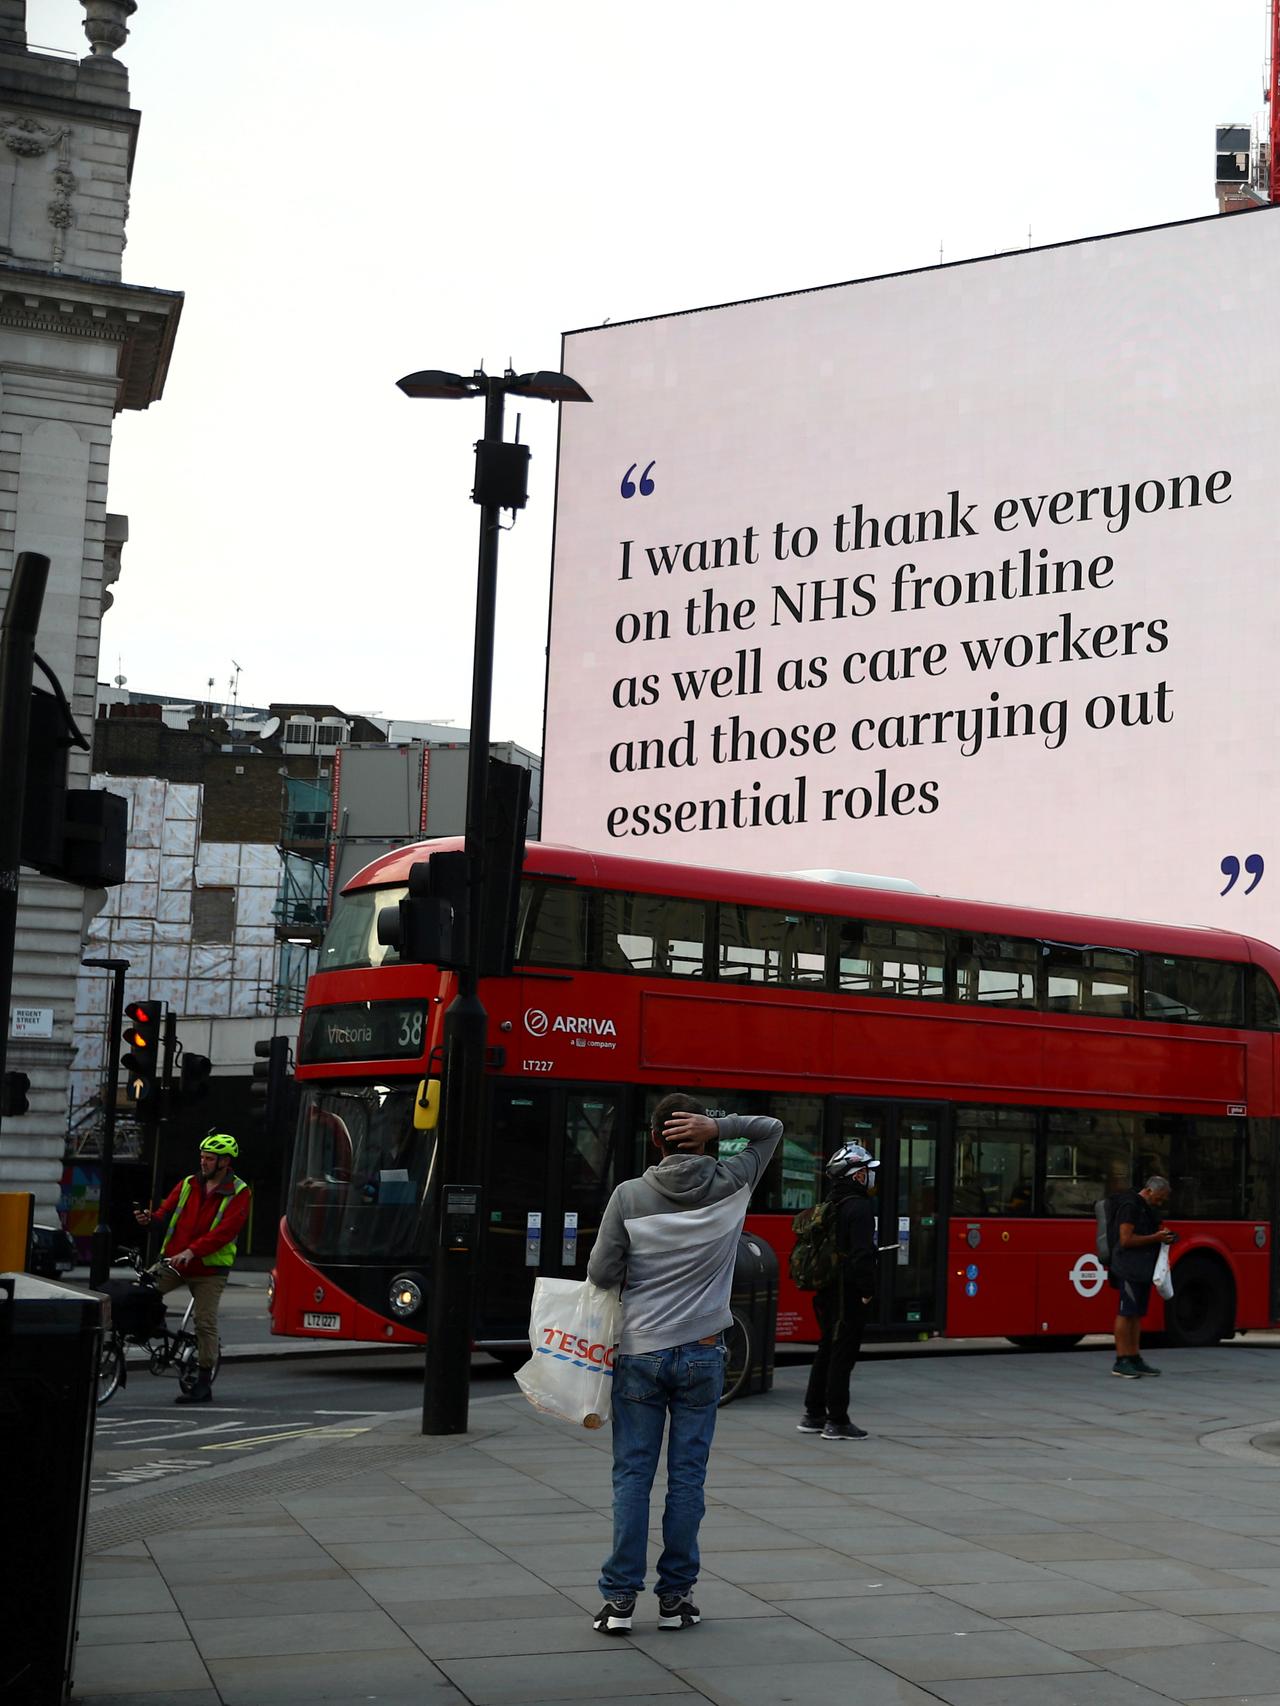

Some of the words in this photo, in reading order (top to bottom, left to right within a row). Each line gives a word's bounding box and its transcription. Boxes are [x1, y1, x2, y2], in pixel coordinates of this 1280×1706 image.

[618, 541, 634, 580] I
[645, 526, 759, 576] want
[773, 522, 818, 560] to
[834, 491, 979, 552] thank
[994, 471, 1231, 533] everyone
[616, 610, 670, 643] on
[685, 588, 755, 636] the
[771, 574, 876, 626] NHS
[891, 549, 1113, 612] frontline
[613, 675, 659, 708] as
[672, 648, 762, 701] well
[777, 657, 827, 691] as
[843, 644, 947, 684] care
[960, 613, 1168, 671] workers
[610, 720, 698, 773] and
[711, 716, 836, 763] those
[852, 692, 1067, 756] carrying
[1086, 681, 1173, 729] out
[607, 776, 807, 837] essential
[823, 769, 938, 821] roles
[327, 1024, 372, 1044] Victoria
[398, 1011, 422, 1045] 38
[552, 1015, 617, 1036] ARRIVA
[587, 1040, 617, 1050] company
[523, 1060, 554, 1072] LT227
